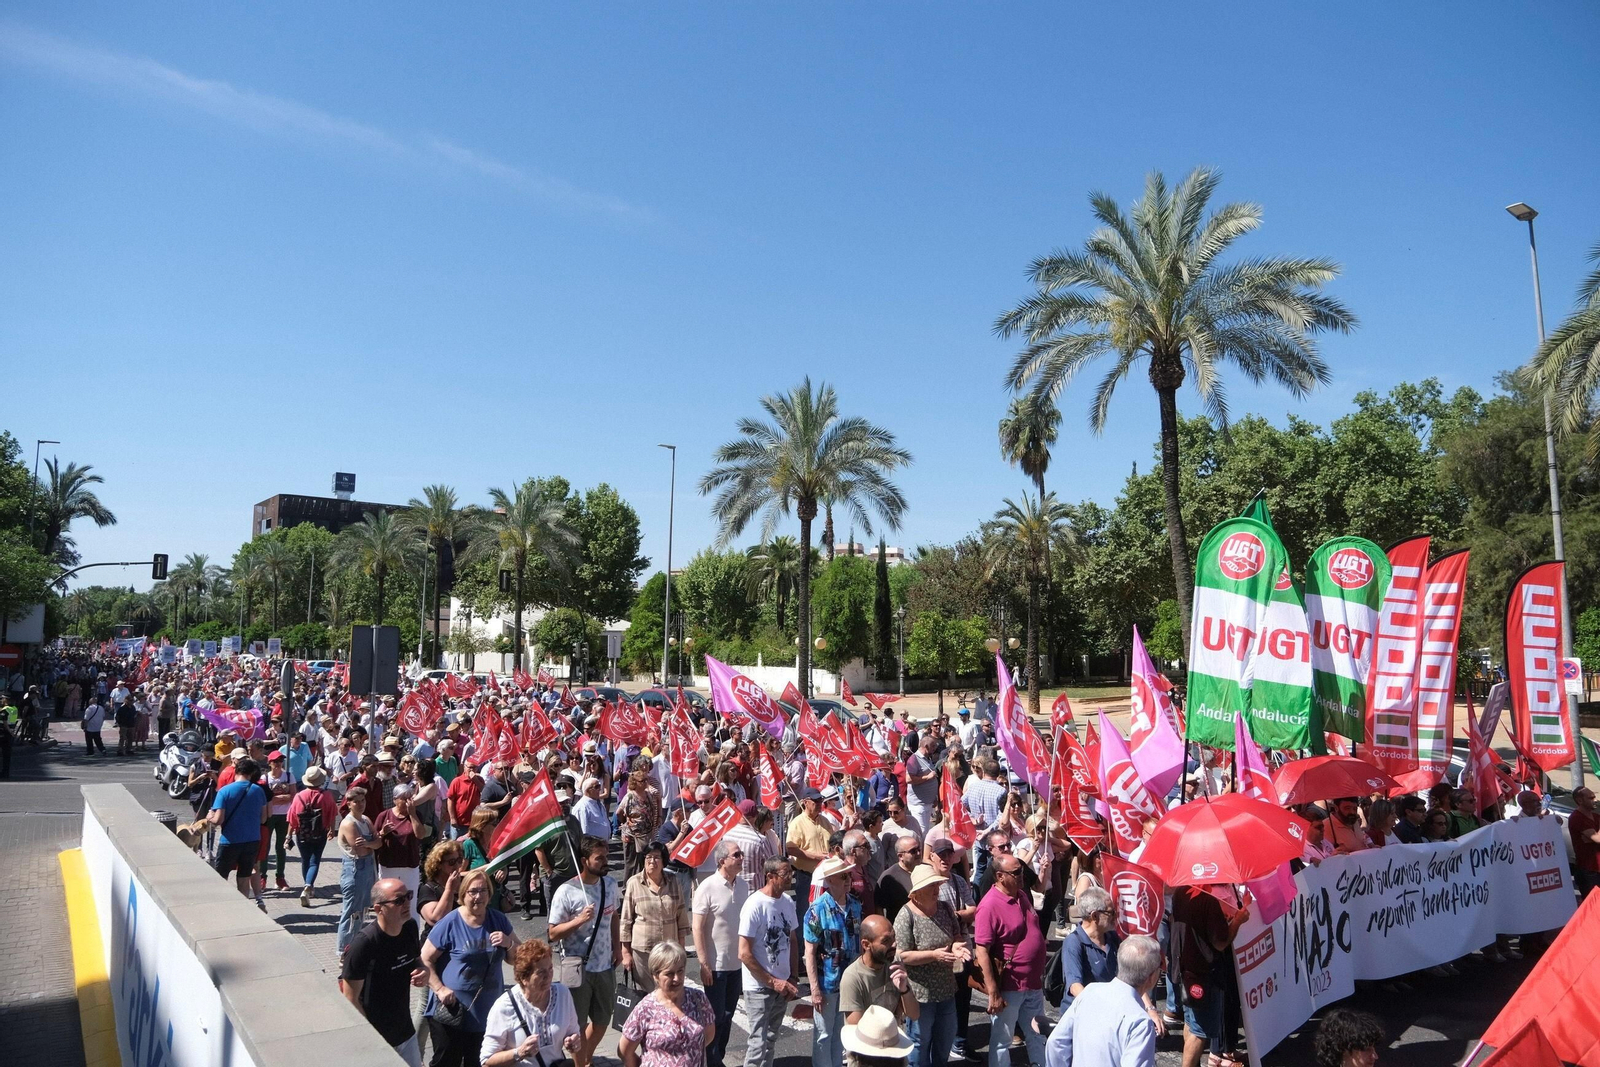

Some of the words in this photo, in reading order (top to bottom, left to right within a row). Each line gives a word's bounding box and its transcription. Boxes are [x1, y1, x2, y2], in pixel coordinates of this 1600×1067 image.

[1225, 539, 1261, 563] UGT
[1333, 554, 1370, 575] UGT
[1203, 616, 1257, 661] UGT
[1313, 619, 1372, 659] UGT
[1373, 566, 1420, 711] CCOO
[1418, 582, 1458, 724] CCOO
[1522, 583, 1561, 713] CCOO
[1252, 707, 1309, 727] ndalucía
[1372, 749, 1413, 761] Córdoba
[1532, 746, 1568, 756] Córdoba
[677, 806, 735, 859] CCOO
[1428, 850, 1463, 883] bajar
[1521, 843, 1543, 860] UGT
[1366, 889, 1419, 937] repartir
[1421, 881, 1489, 921] beneficios
[1293, 887, 1352, 997] MAYO
[1312, 970, 1332, 997] 2023
